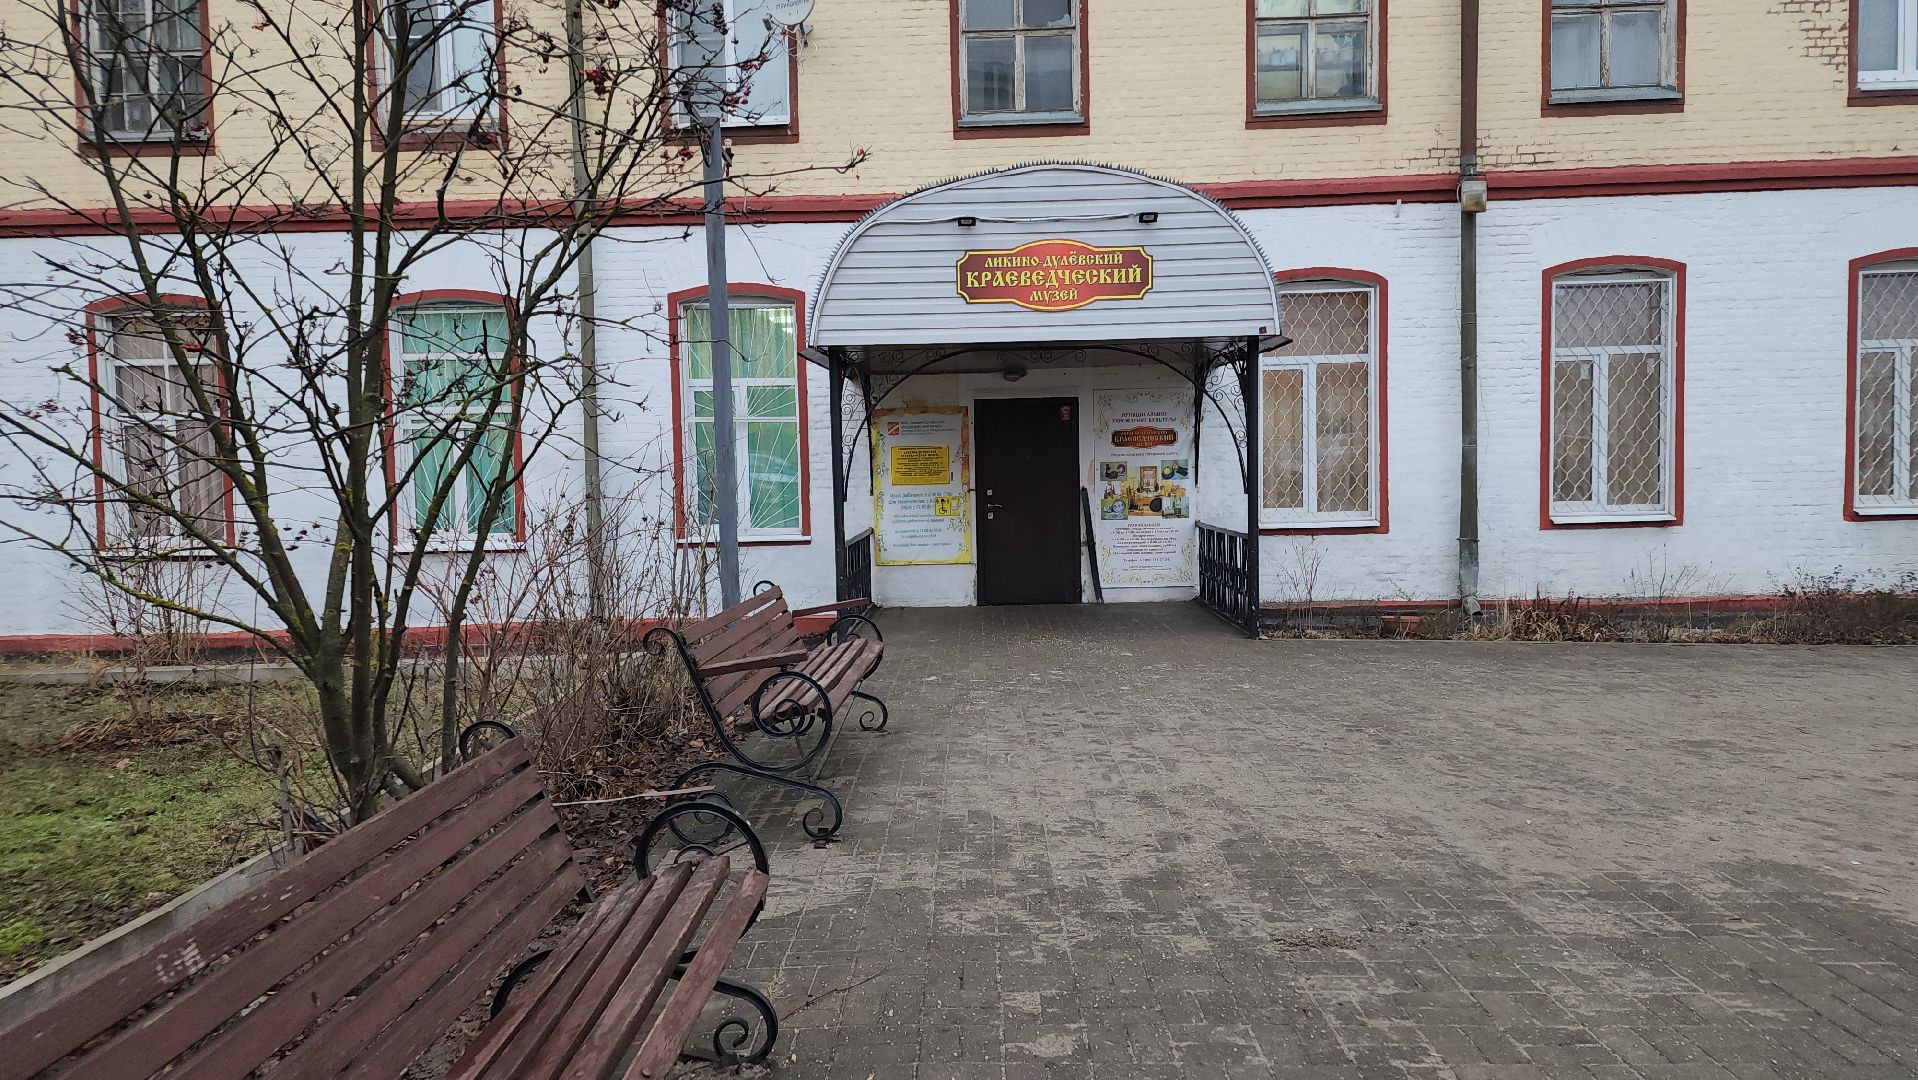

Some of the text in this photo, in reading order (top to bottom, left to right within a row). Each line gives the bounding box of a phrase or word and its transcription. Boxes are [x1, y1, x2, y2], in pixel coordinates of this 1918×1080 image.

[984, 251, 1123, 269] ЛИКИНО-ДУЛЁВСКИЙ
[966, 264, 1142, 288] КРАЕВЕДЧЕСКИЙ
[1029, 288, 1079, 304] МУЗЕЙ
